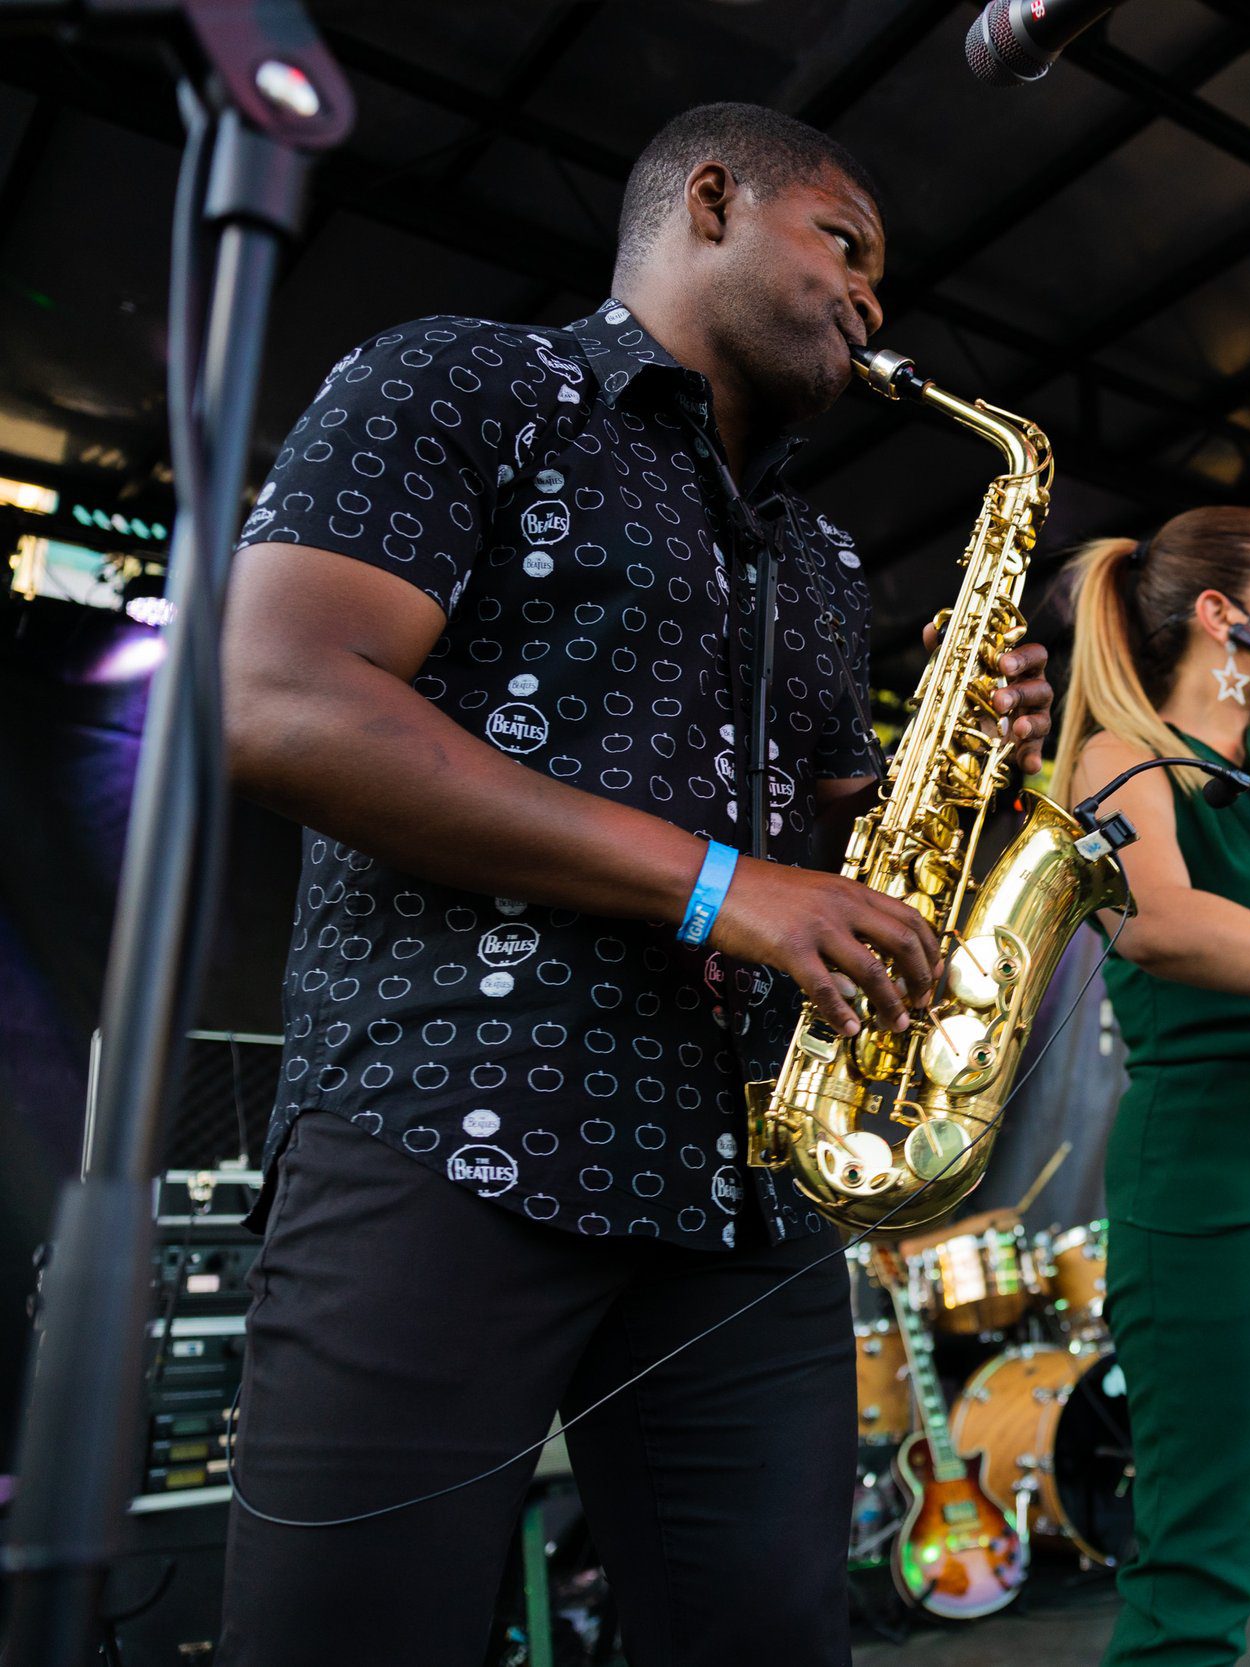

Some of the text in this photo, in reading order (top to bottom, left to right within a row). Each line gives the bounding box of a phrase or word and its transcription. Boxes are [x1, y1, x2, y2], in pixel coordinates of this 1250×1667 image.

[526, 558, 551, 570] BEATLES
[511, 680, 536, 690] BEATLES
[513, 714, 526, 722] THE
[491, 713, 545, 740] BEATLES
[484, 935, 536, 955] BEATLES
[454, 1158, 514, 1183] BEATLES
